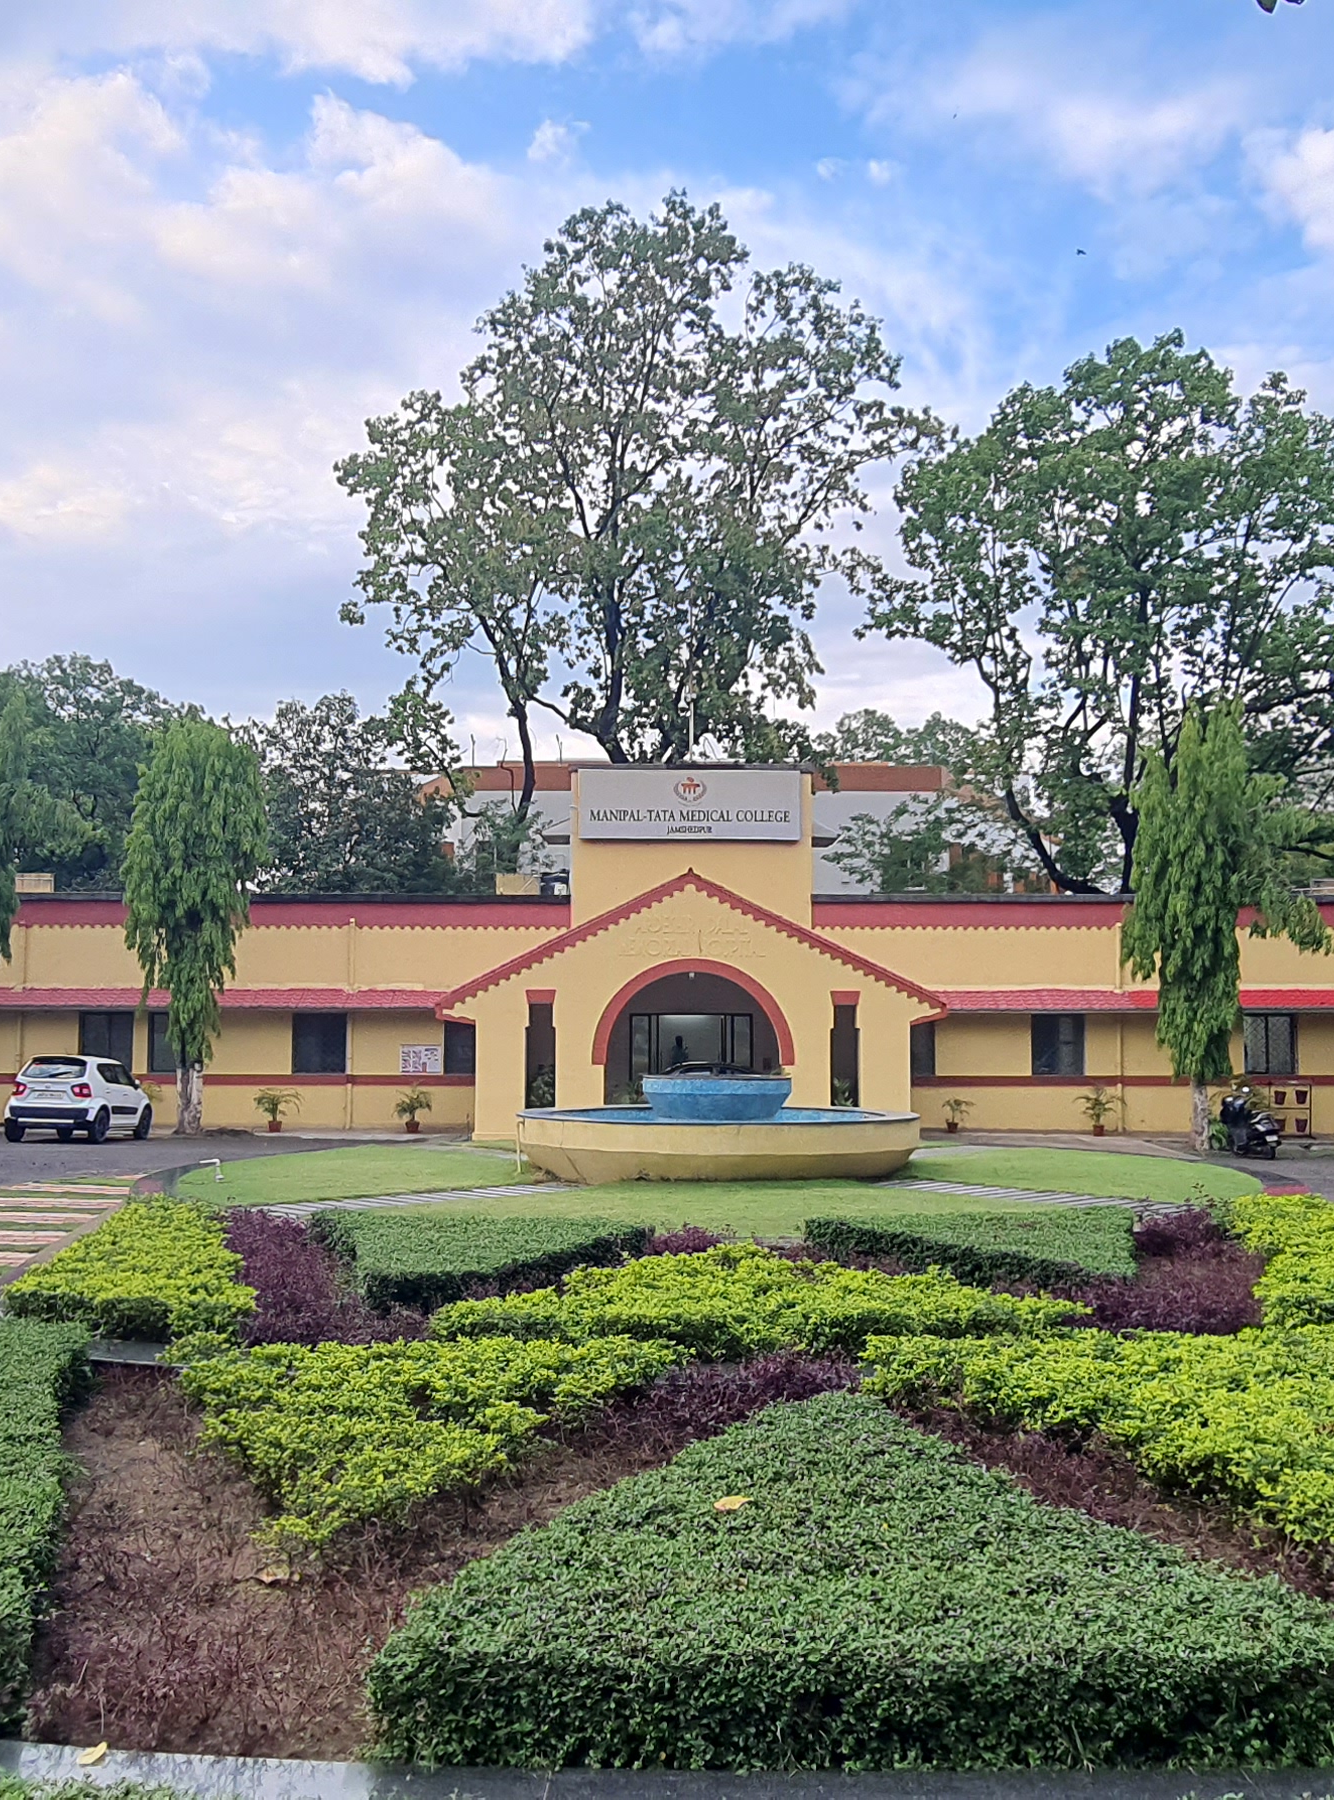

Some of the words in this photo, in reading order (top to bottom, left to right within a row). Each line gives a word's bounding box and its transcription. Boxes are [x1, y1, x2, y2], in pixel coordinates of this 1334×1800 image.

[589, 809, 676, 822] MANIPAL-TATA
[679, 809, 733, 822] MEDICAL
[736, 809, 791, 823] COLLEGE
